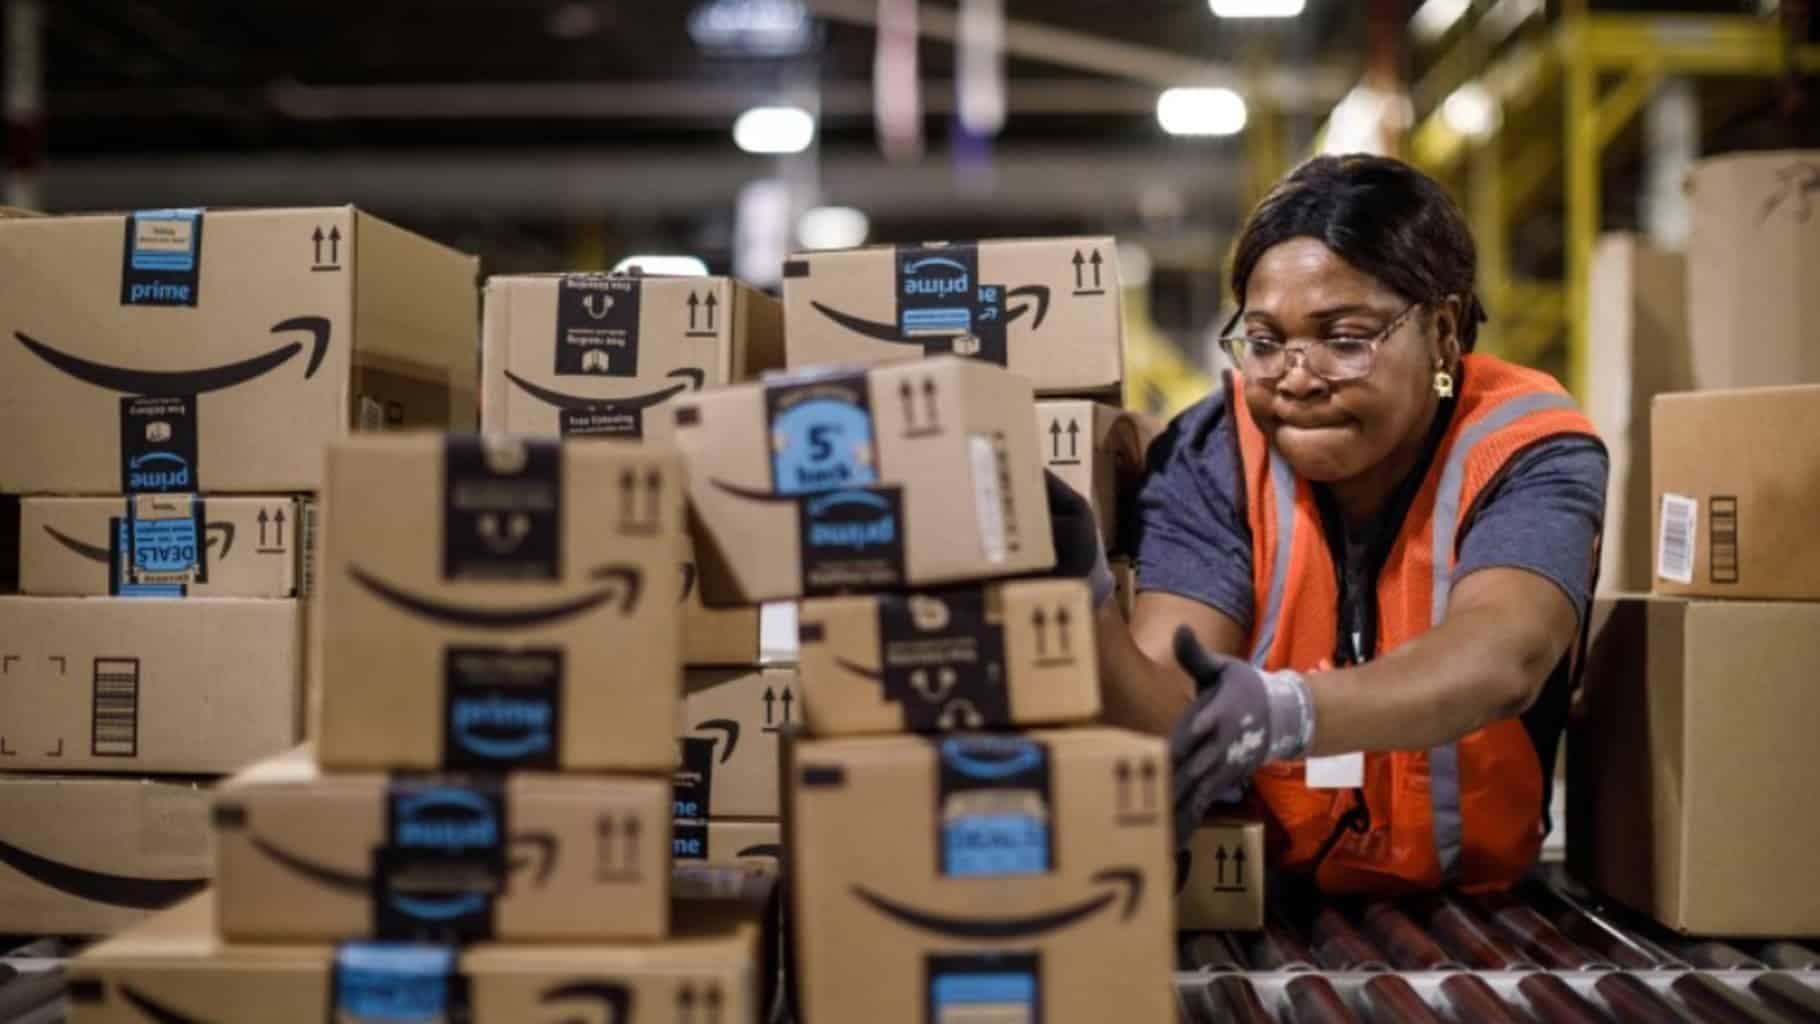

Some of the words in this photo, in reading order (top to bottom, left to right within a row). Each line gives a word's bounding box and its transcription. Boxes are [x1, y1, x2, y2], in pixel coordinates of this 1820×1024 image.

[131, 280, 190, 302] prime
[903, 274, 969, 299] prime
[130, 467, 190, 491] prime
[137, 545, 194, 564] DEALS
